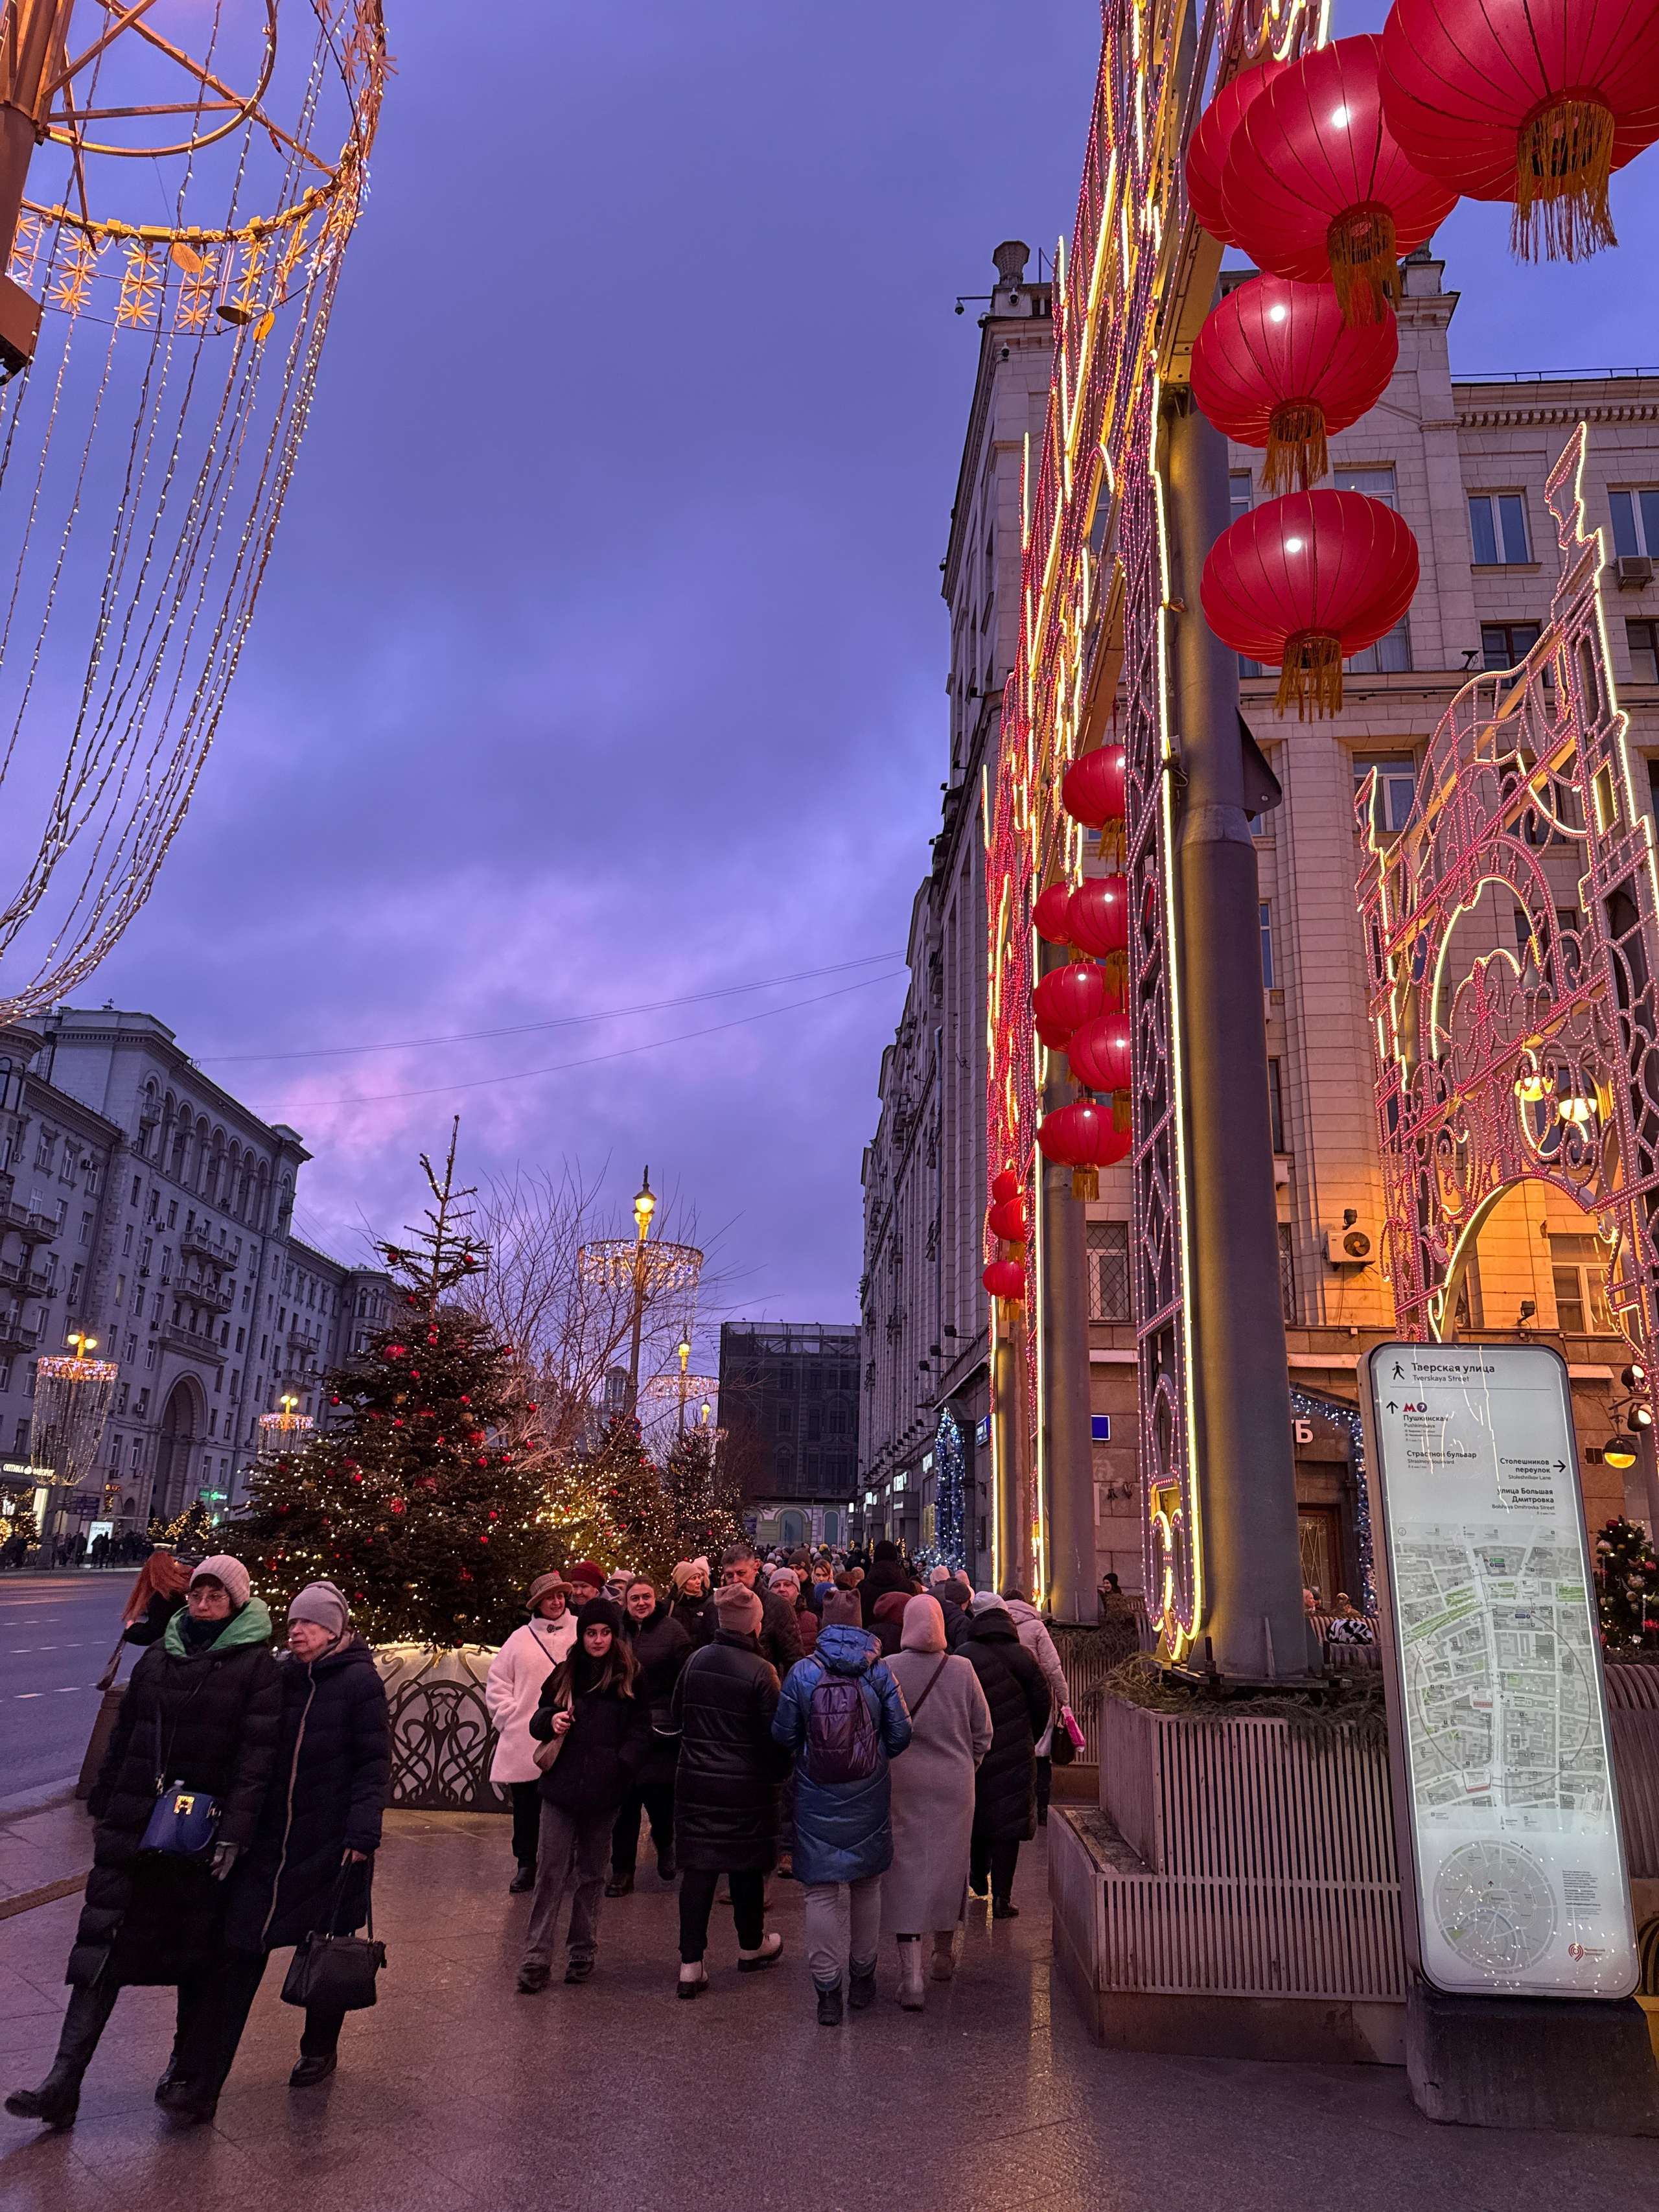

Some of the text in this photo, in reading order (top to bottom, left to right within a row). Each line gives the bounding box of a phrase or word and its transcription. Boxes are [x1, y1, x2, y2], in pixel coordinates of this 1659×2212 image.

[1411, 1362, 1495, 1374] Тверская улица
[1291, 1419, 1314, 1443] Б
[1446, 1450, 1477, 1459] бульвар
[1512, 1495, 1555, 1504] Дмитровка
